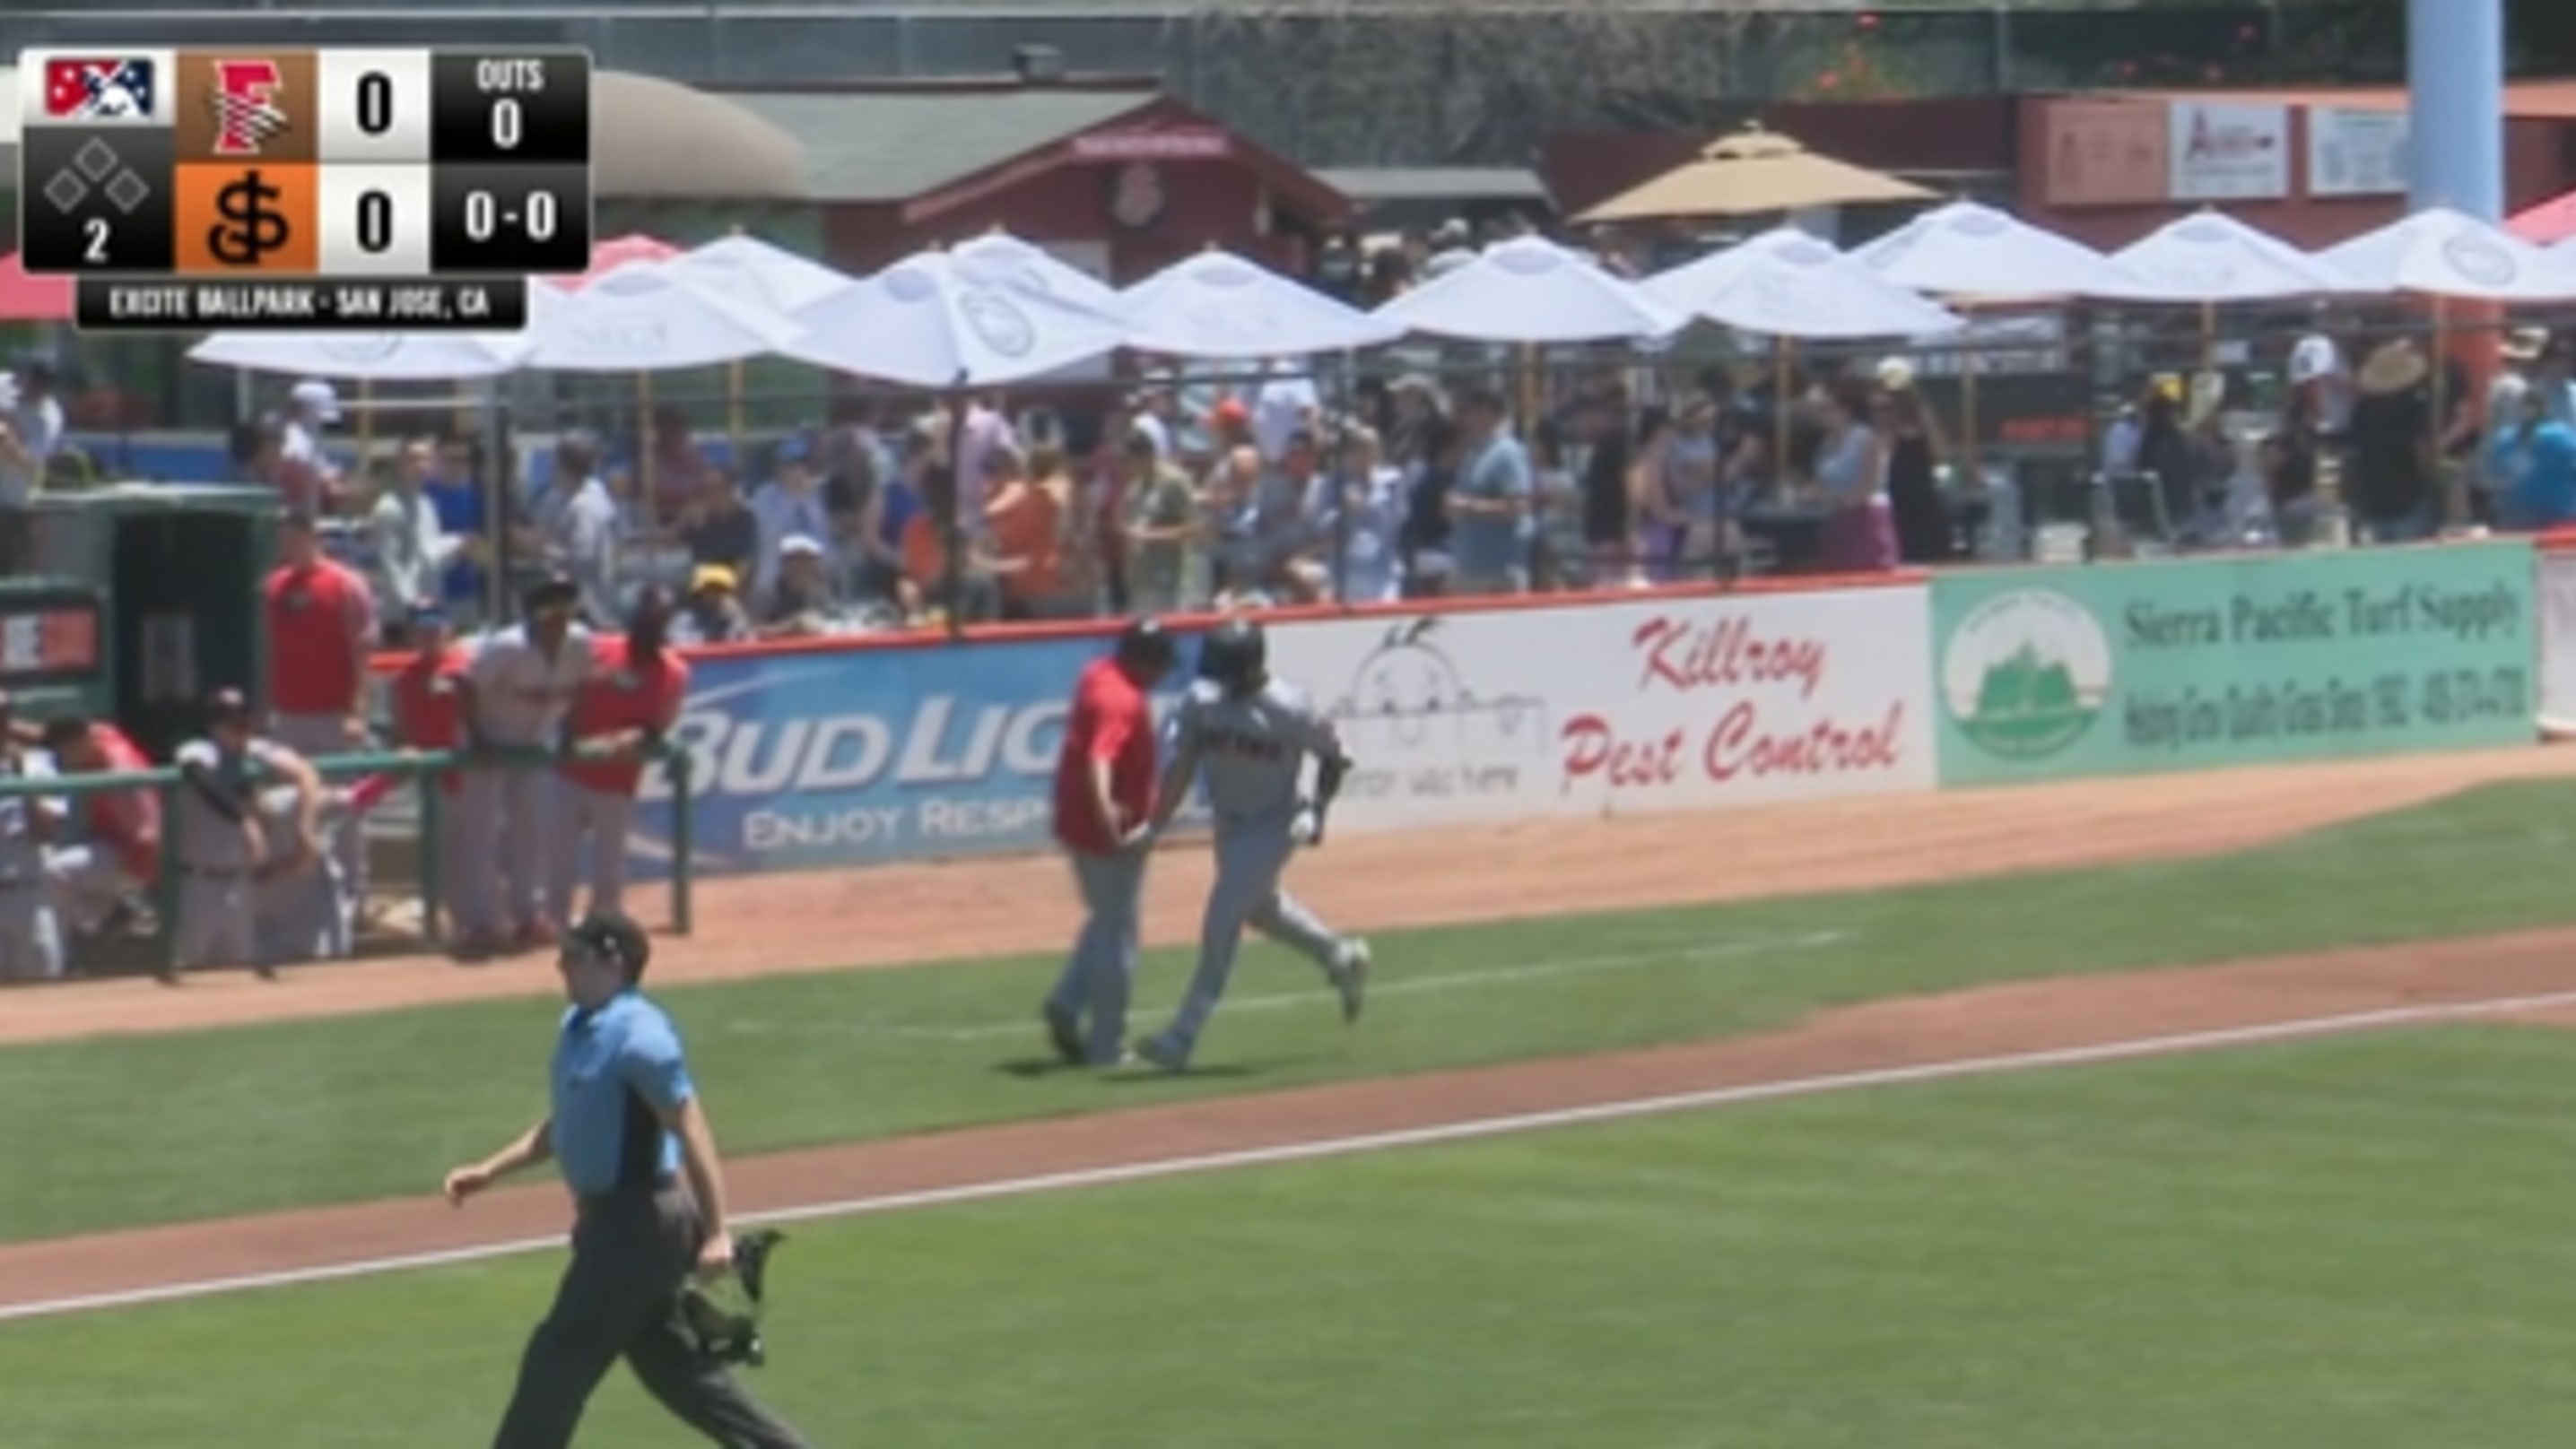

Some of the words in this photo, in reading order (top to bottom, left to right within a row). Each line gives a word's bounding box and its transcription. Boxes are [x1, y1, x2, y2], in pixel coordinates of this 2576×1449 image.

[2124, 597, 2219, 647] Sierra
[2230, 591, 2335, 643] Pacific
[2343, 583, 2413, 635] Turf
[2419, 579, 2519, 641] Supply
[1632, 615, 1825, 700] Killroy
[899, 693, 1121, 786] LIG
[1561, 713, 1683, 795] Pest
[1703, 699, 1904, 781] Control
[744, 804, 900, 849] ENJOY
[922, 794, 1051, 836] RESP
